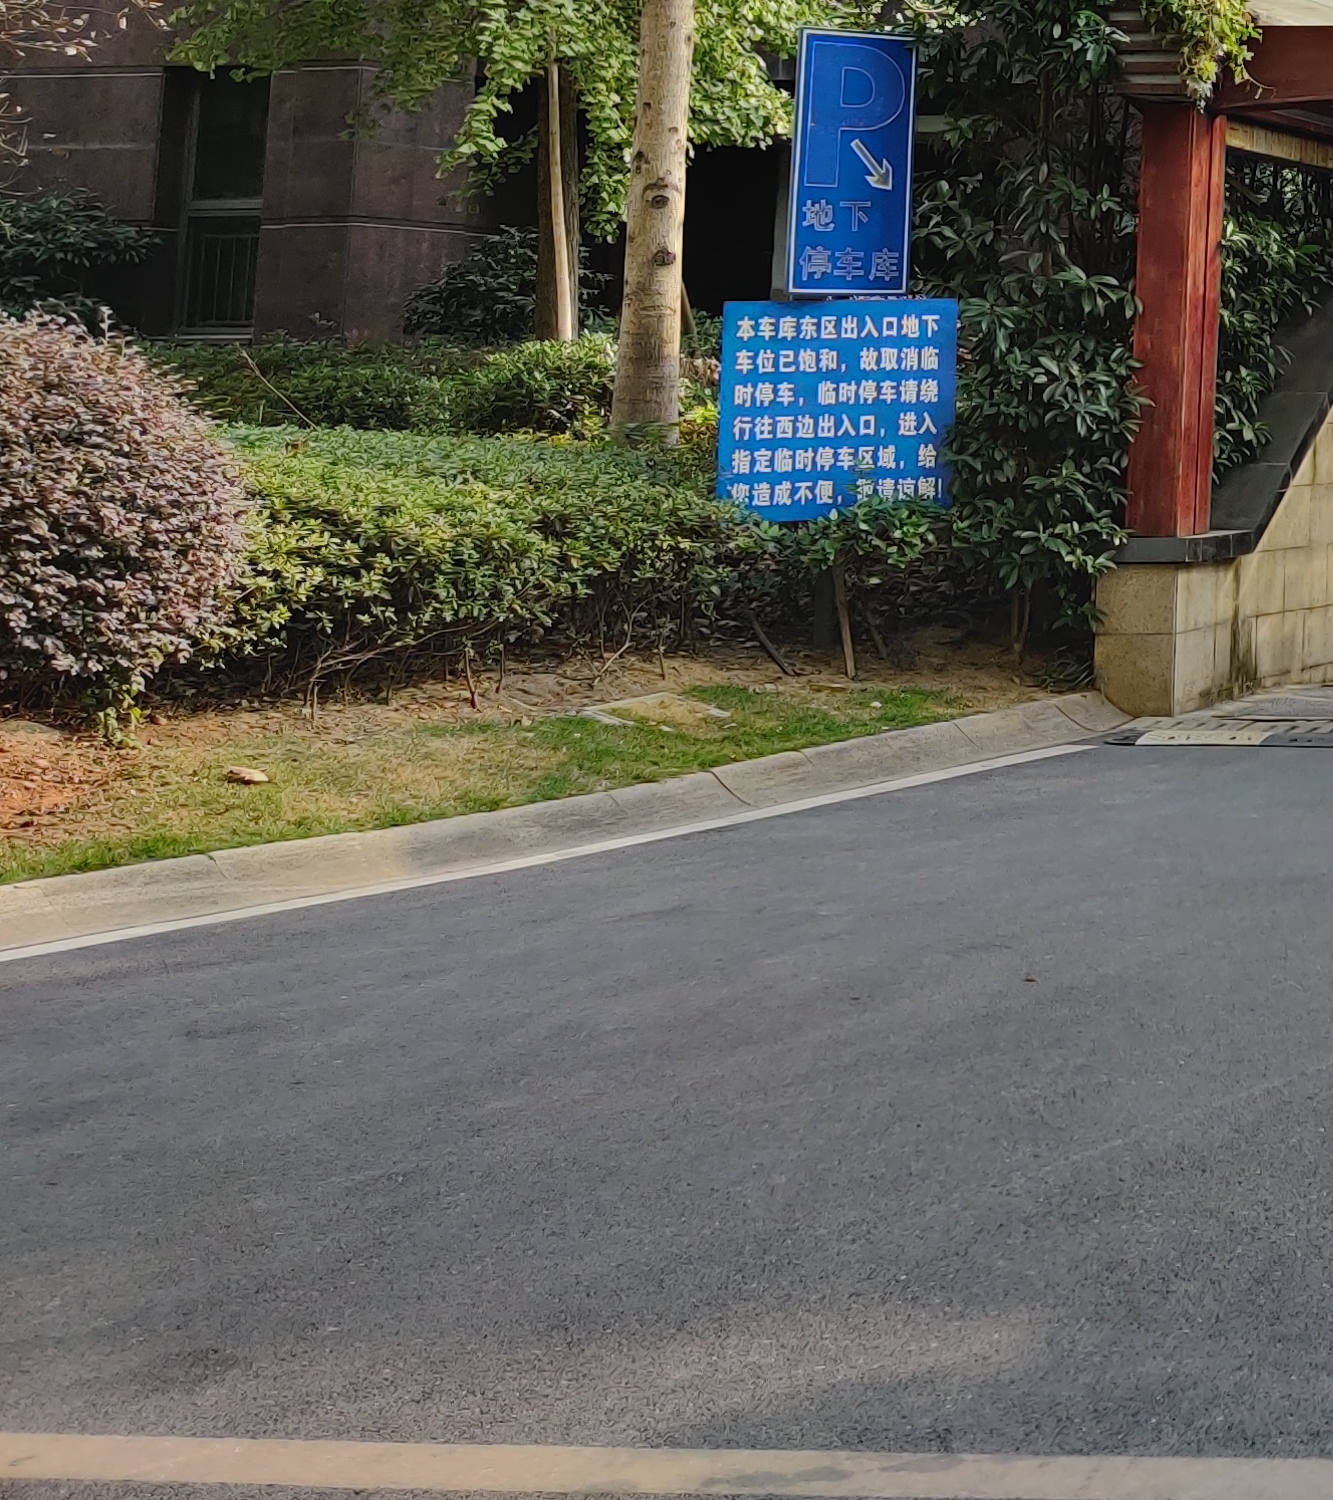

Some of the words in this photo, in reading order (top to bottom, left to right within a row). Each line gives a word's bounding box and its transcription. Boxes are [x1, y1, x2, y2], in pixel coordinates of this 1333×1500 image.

[804, 41, 906, 188] P
[802, 199, 872, 232] 地下
[799, 245, 900, 281] 停车库
[735, 314, 941, 341] 本车库东区出入口地下
[734, 346, 940, 375] 车位已饱和，故取消临
[733, 378, 939, 408] 时停车，临时停车请绕
[732, 411, 938, 441] 行往西边出入口，进入
[731, 443, 938, 474] 指定临时停车区域，给
